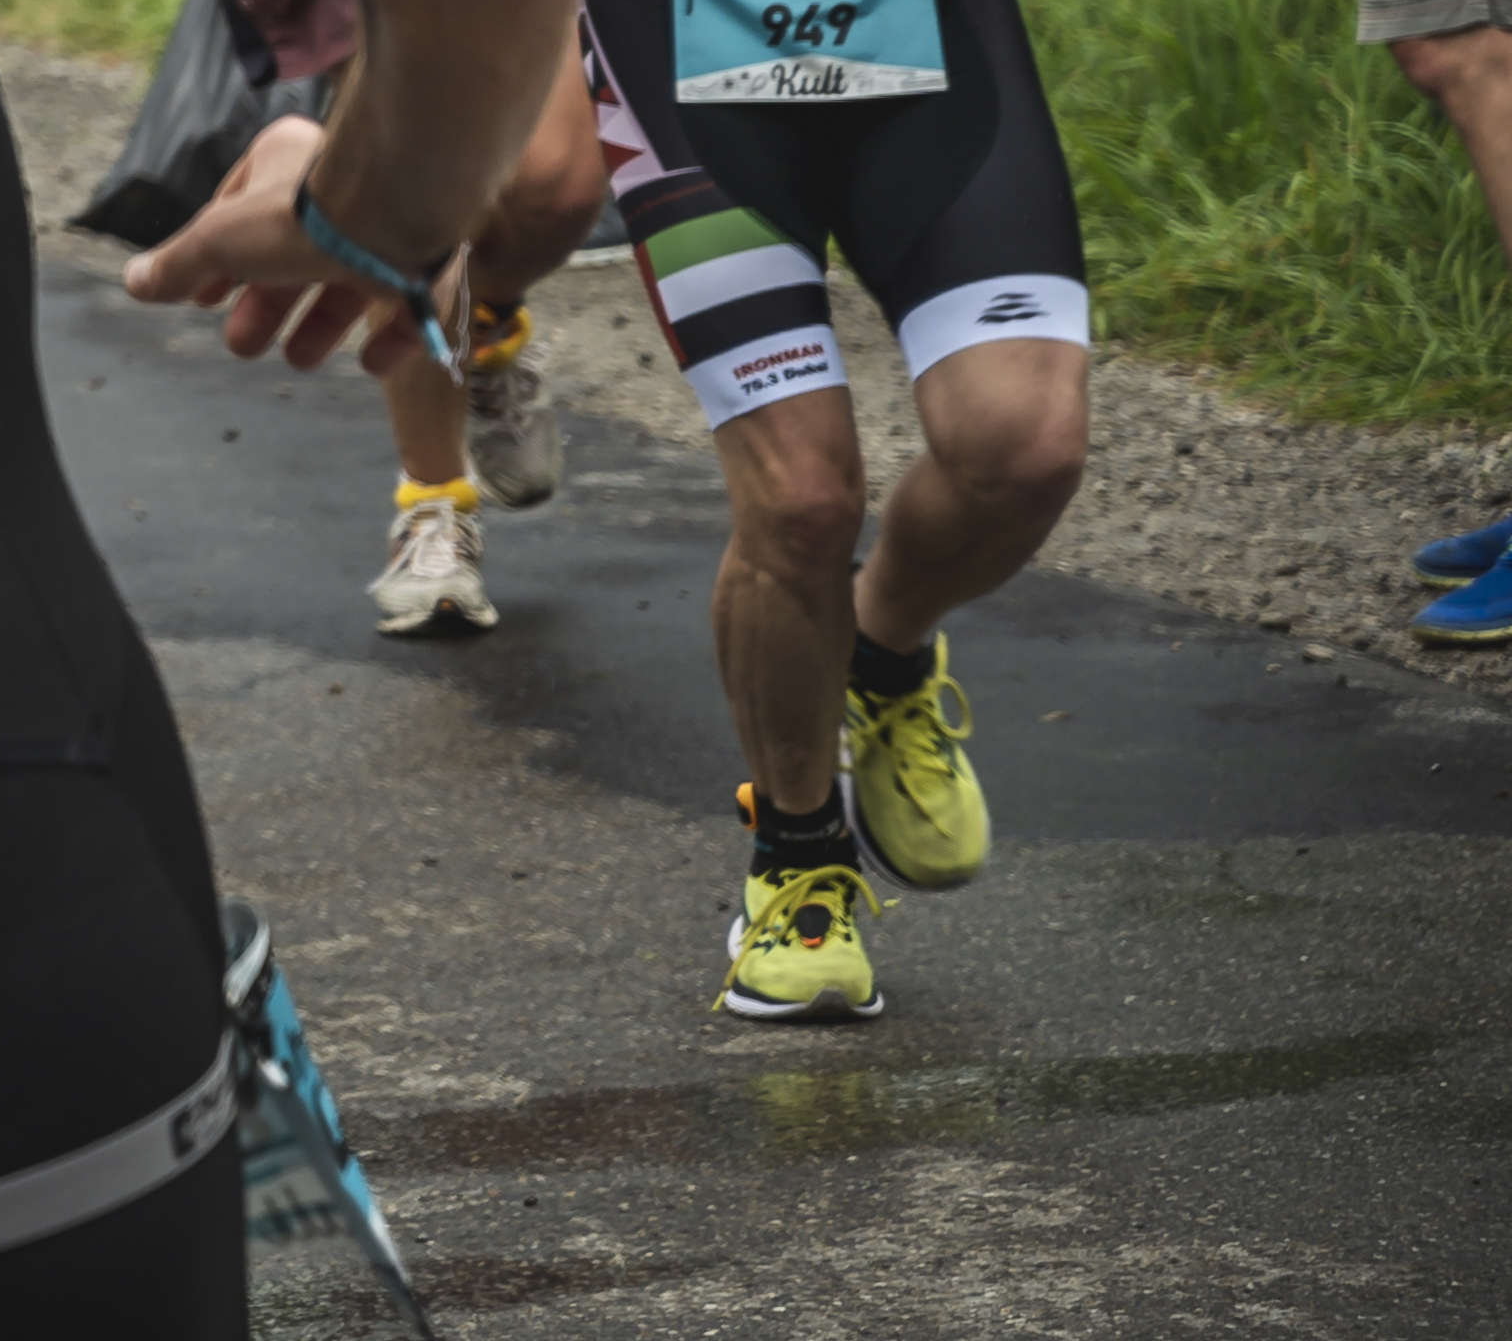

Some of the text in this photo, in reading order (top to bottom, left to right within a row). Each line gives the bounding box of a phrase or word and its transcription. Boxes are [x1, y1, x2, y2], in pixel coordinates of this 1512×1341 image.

[763, 3, 859, 48] 949
[770, 64, 850, 96] Kult
[733, 342, 826, 380] IRONMAN
